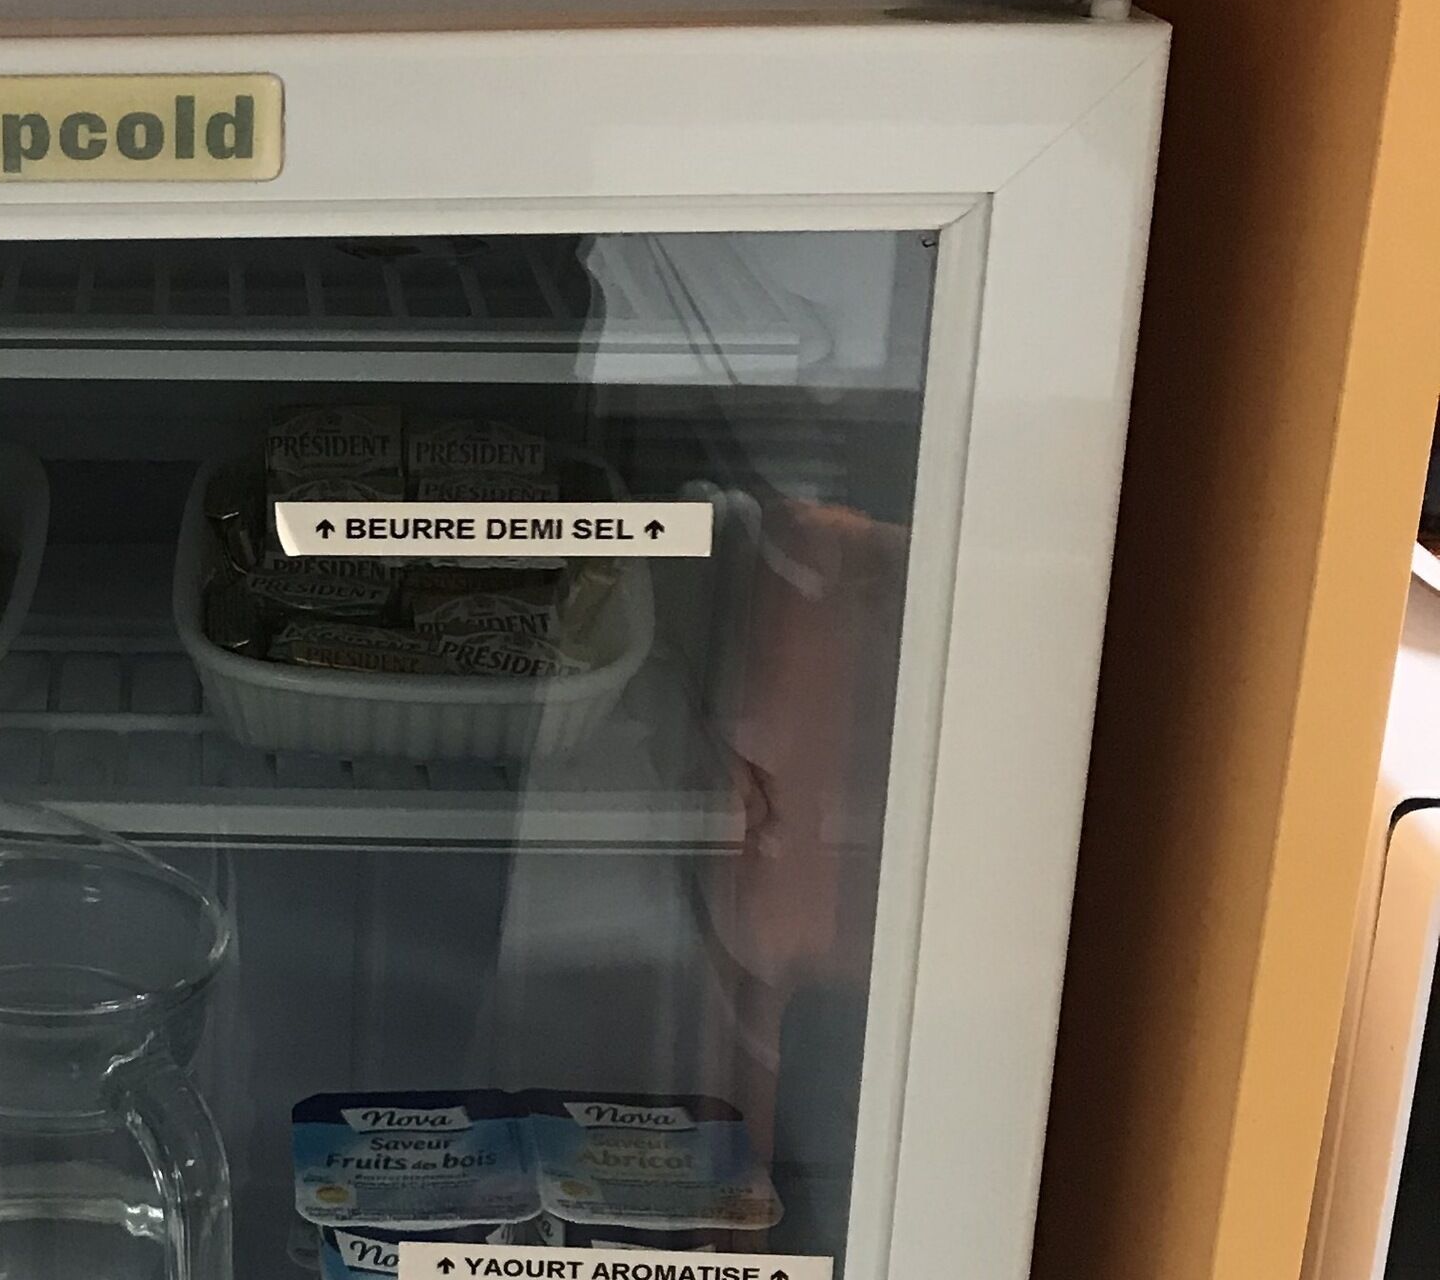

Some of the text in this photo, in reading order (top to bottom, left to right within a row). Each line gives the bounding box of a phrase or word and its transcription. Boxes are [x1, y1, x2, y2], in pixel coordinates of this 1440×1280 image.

[345, 518, 634, 541] BEURRE DEMI SEL
[361, 1109, 455, 1127] Nova
[585, 1105, 678, 1126] Nova
[369, 1137, 456, 1151] Saveur
[325, 1151, 498, 1170] Fruits des bois
[577, 1149, 695, 1169] Abricot
[349, 1240, 400, 1267] No
[464, 1257, 584, 1280] YAOURT
